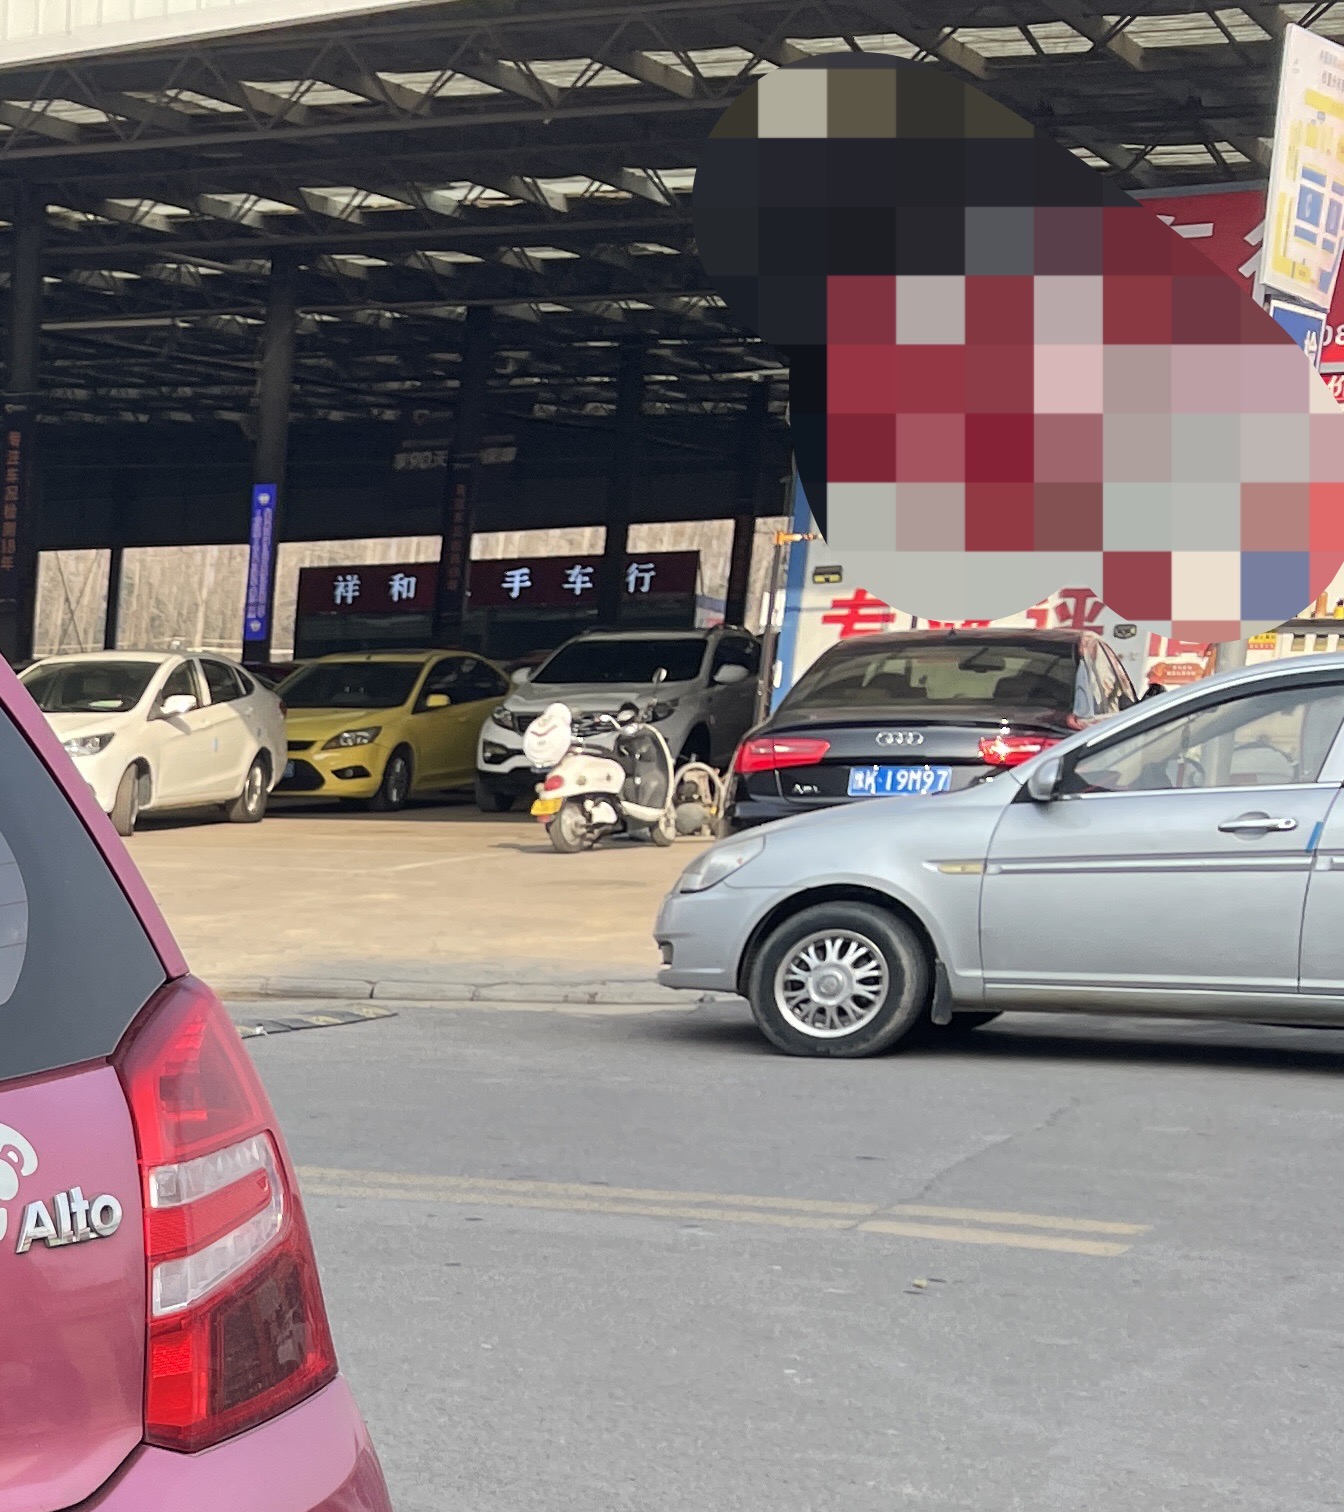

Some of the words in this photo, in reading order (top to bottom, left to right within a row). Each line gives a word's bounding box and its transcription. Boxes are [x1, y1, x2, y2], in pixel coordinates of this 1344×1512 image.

[332, 563, 657, 605] 祥和手车行
[15, 1186, 123, 1256] Alto
